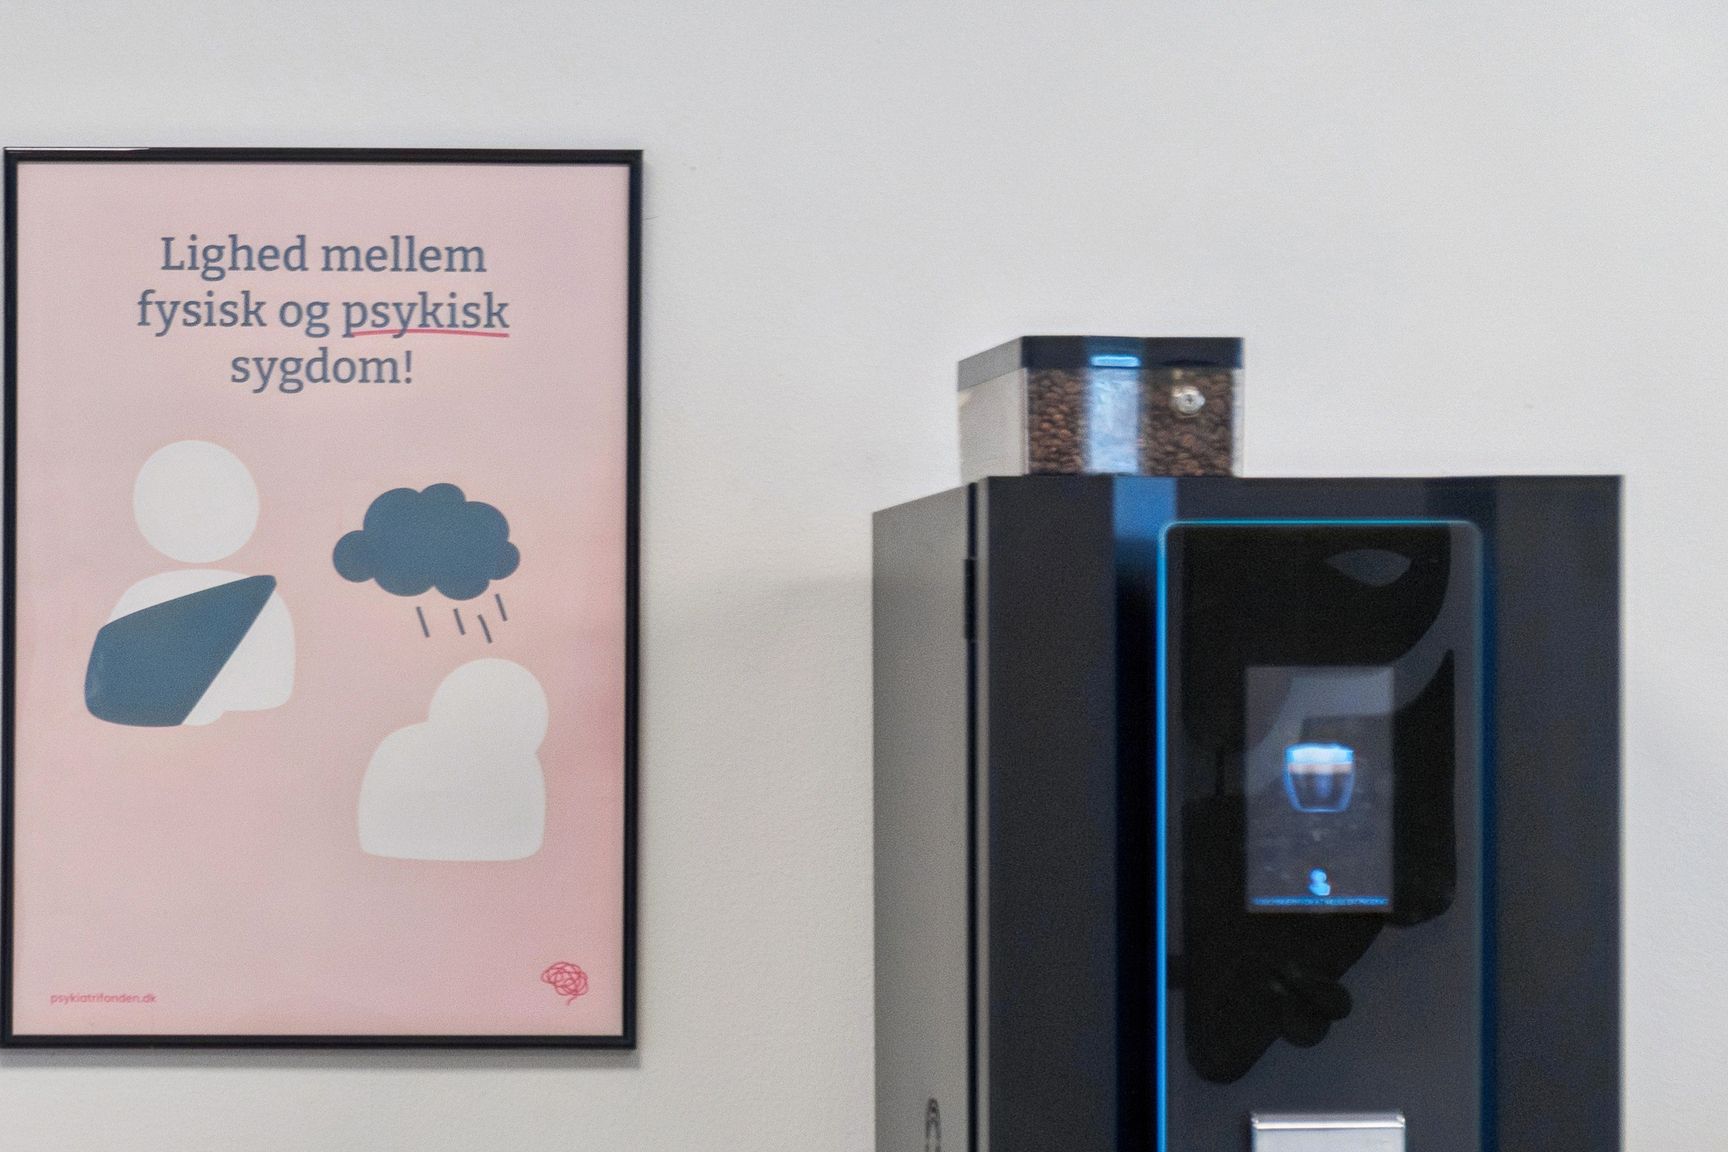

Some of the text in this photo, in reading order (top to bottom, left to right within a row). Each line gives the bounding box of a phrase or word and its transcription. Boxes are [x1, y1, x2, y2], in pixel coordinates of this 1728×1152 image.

[160, 233, 488, 282] Lighed mellem
[136, 288, 510, 340] fysisk og psykisk
[229, 346, 414, 394] sygdom!
[49, 993, 158, 1005] psykiatrifonden.dk
